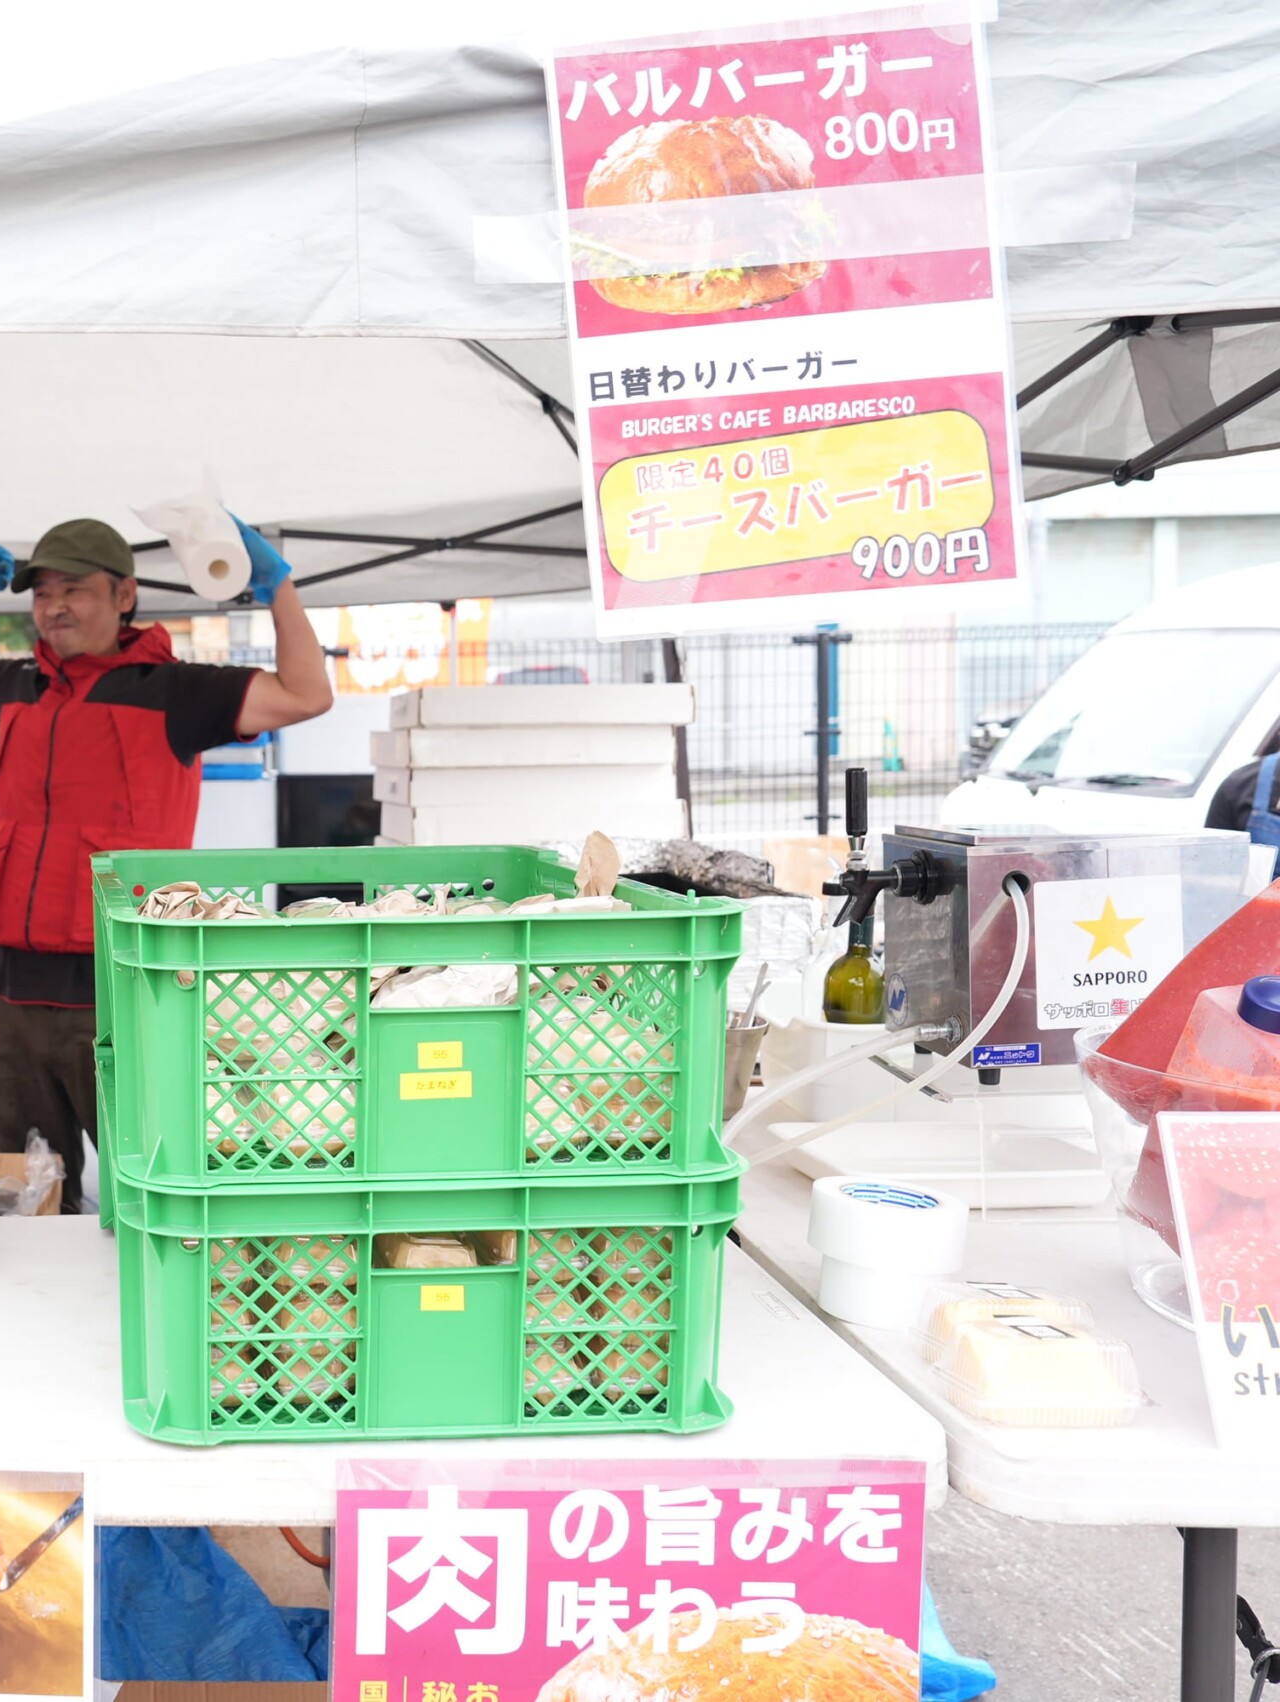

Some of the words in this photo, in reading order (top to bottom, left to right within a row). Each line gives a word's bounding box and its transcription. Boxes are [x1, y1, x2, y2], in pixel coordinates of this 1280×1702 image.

[565, 42, 934, 121] バルバーガー
[824, 109, 956, 160] 800円
[589, 351, 858, 401] 日替わりバーガー
[622, 414, 713, 438] BURGER'S
[719, 409, 771, 430] CAFE
[783, 396, 915, 424] BARBARESCO
[636, 448, 790, 493] 限定40個
[628, 465, 984, 552] チーズバーガー
[852, 528, 990, 580] 900円
[1073, 970, 1148, 987] SAPPORO
[356, 1485, 528, 1656] 肉
[549, 1487, 904, 1565] の旨みを
[546, 1578, 807, 1655] 味わう
